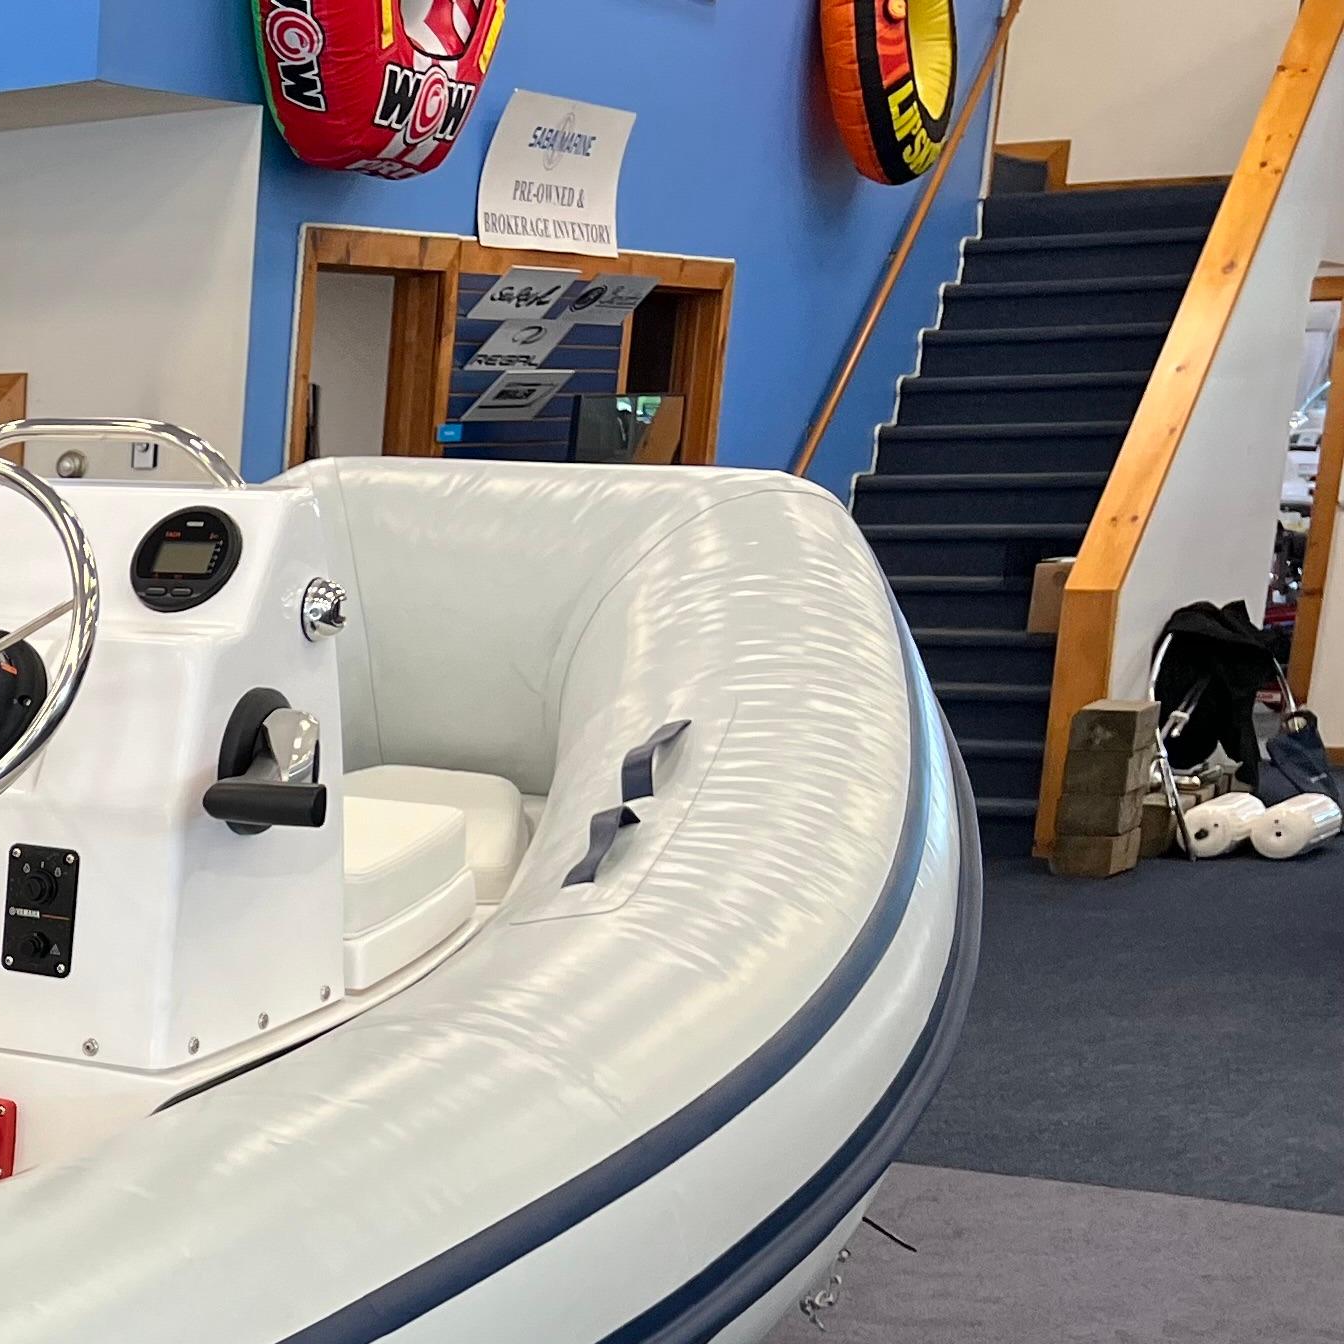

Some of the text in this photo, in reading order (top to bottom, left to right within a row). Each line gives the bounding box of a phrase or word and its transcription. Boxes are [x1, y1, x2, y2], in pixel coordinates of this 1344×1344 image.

[265, 0, 327, 113] OW
[374, 63, 477, 145] WOW
[513, 180, 585, 209] PRE-OWNED &
[483, 212, 612, 245] BROKERAGE INVENTORY
